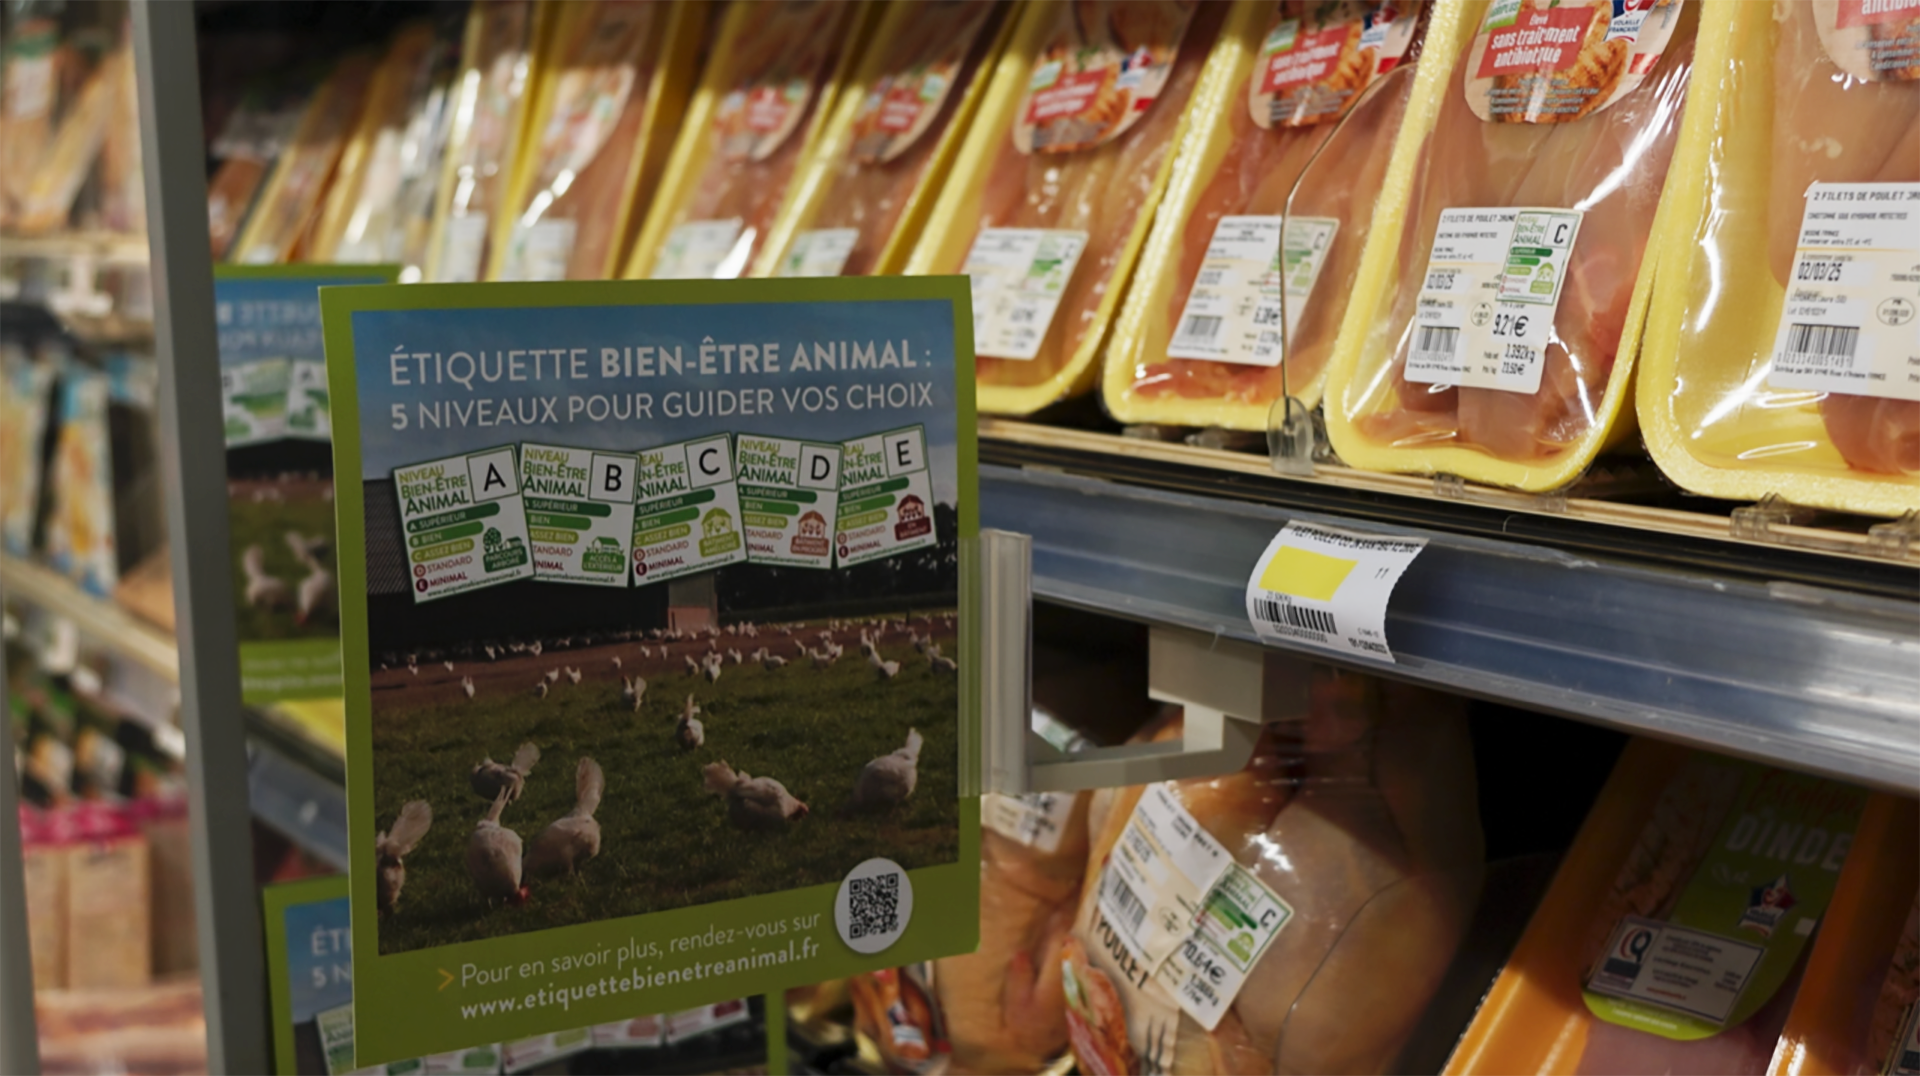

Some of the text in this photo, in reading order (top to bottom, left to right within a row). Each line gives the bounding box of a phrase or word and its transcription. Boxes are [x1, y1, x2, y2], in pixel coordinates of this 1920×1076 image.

[1491, 33, 1517, 50] sans
[1814, 192, 1820, 201] 2
[1822, 192, 1854, 201] FILETS
[1856, 192, 1867, 201] DE
[1869, 191, 1904, 201] POULET
[1475, 214, 1498, 223] POULET
[1554, 224, 1568, 244] C
[1797, 262, 1842, 282] 02/03/25
[389, 344, 589, 390] ÉTIQUETTE
[601, 335, 780, 379] BIEN-ÊTRE
[790, 339, 917, 372] ANIMAL
[392, 381, 933, 430] 5 NIVEAUX POUR GUIDER VOS CHOIX
[525, 448, 569, 464] NIVEAU
[740, 439, 780, 454] NIVEAU
[896, 439, 912, 467] E
[523, 460, 588, 481] BIEN-ÊTRE
[699, 448, 720, 475] C
[739, 451, 797, 470] BIEN-ÊTRE
[811, 454, 830, 480] D
[399, 465, 445, 483] NIVEAU
[484, 462, 506, 492] A
[604, 463, 623, 492] B
[737, 464, 794, 486] ANIMAL
[400, 474, 467, 500] BIEN-ÊTRE
[522, 475, 586, 498] ANIMAL
[405, 490, 470, 517] ANIMAL
[531, 499, 579, 513] SUPÉRIEUR
[639, 496, 684, 514] SUPÉRIEUR
[409, 511, 467, 531] A SUPÉRIEUR
[530, 515, 551, 525] BIEN
[641, 518, 661, 529] BIEN
[421, 533, 443, 544] BIEN
[423, 546, 450, 559] ASSEZ
[450, 541, 472, 553] BIEN
[646, 541, 690, 558] STANDARD
[427, 556, 473, 573] STANDARD
[648, 556, 685, 572] MINIMAL
[429, 571, 468, 588] MINIMAL
[1724, 813, 1856, 872] DINDE
[1259, 908, 1277, 928] C
[461, 911, 821, 988] Pour en savoir plus, rendez-vous sur
[460, 937, 821, 1020] www.etiquettebienetreanimal.fr
